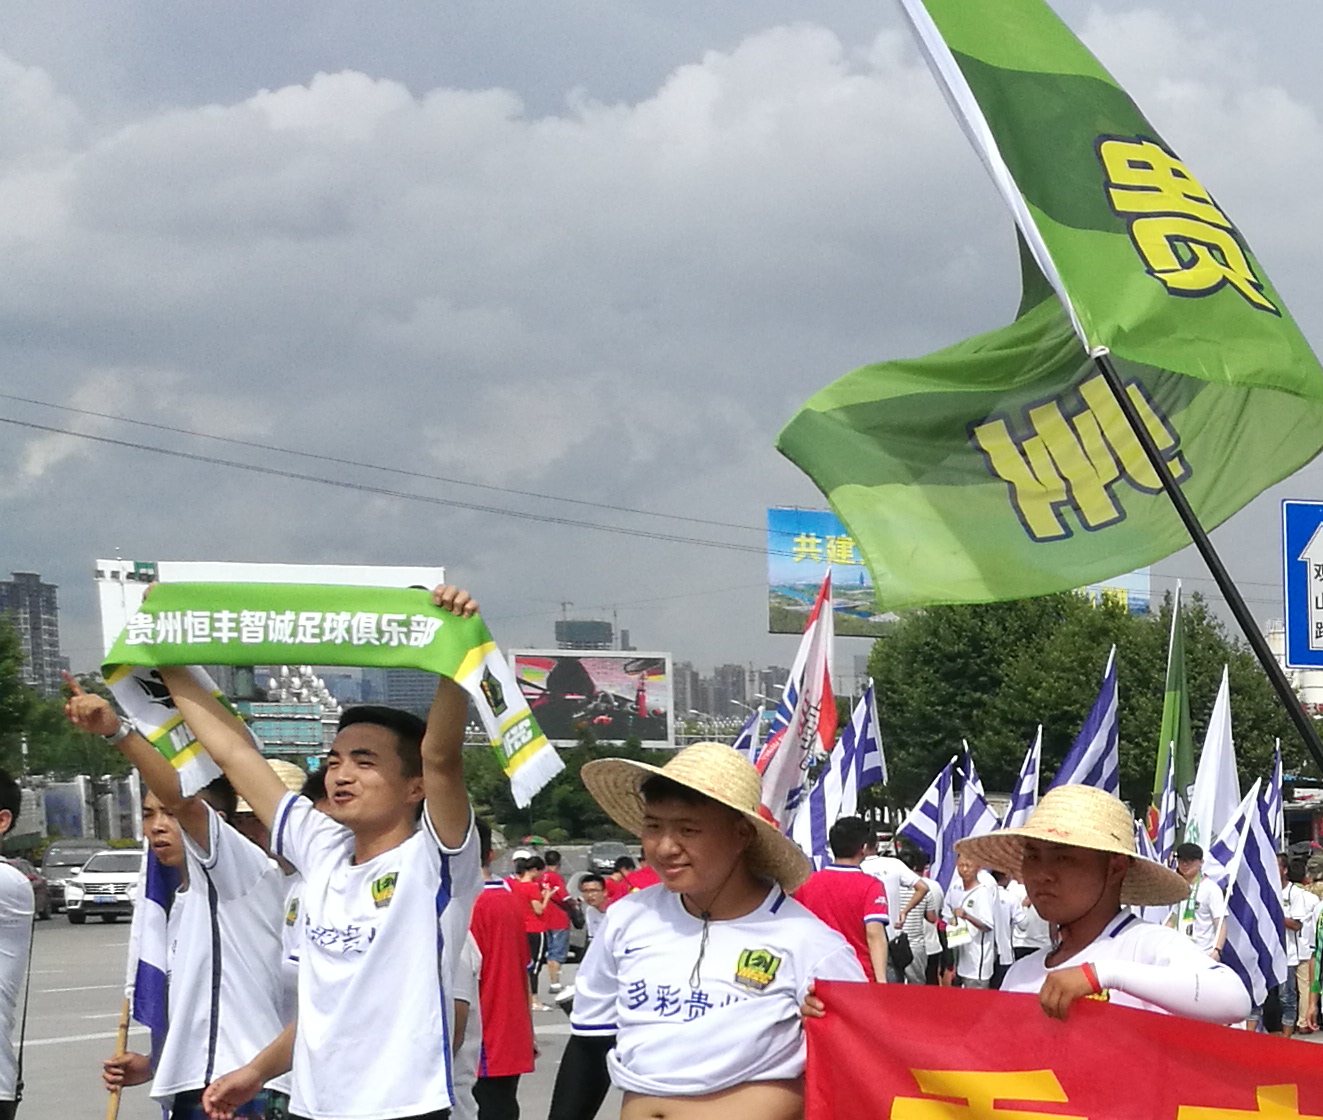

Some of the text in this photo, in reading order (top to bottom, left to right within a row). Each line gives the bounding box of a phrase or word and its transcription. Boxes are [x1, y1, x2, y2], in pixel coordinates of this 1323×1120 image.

[792, 533, 865, 565] 共建
[125, 610, 443, 648] 贵州恒丰智诚足球俱乐部
